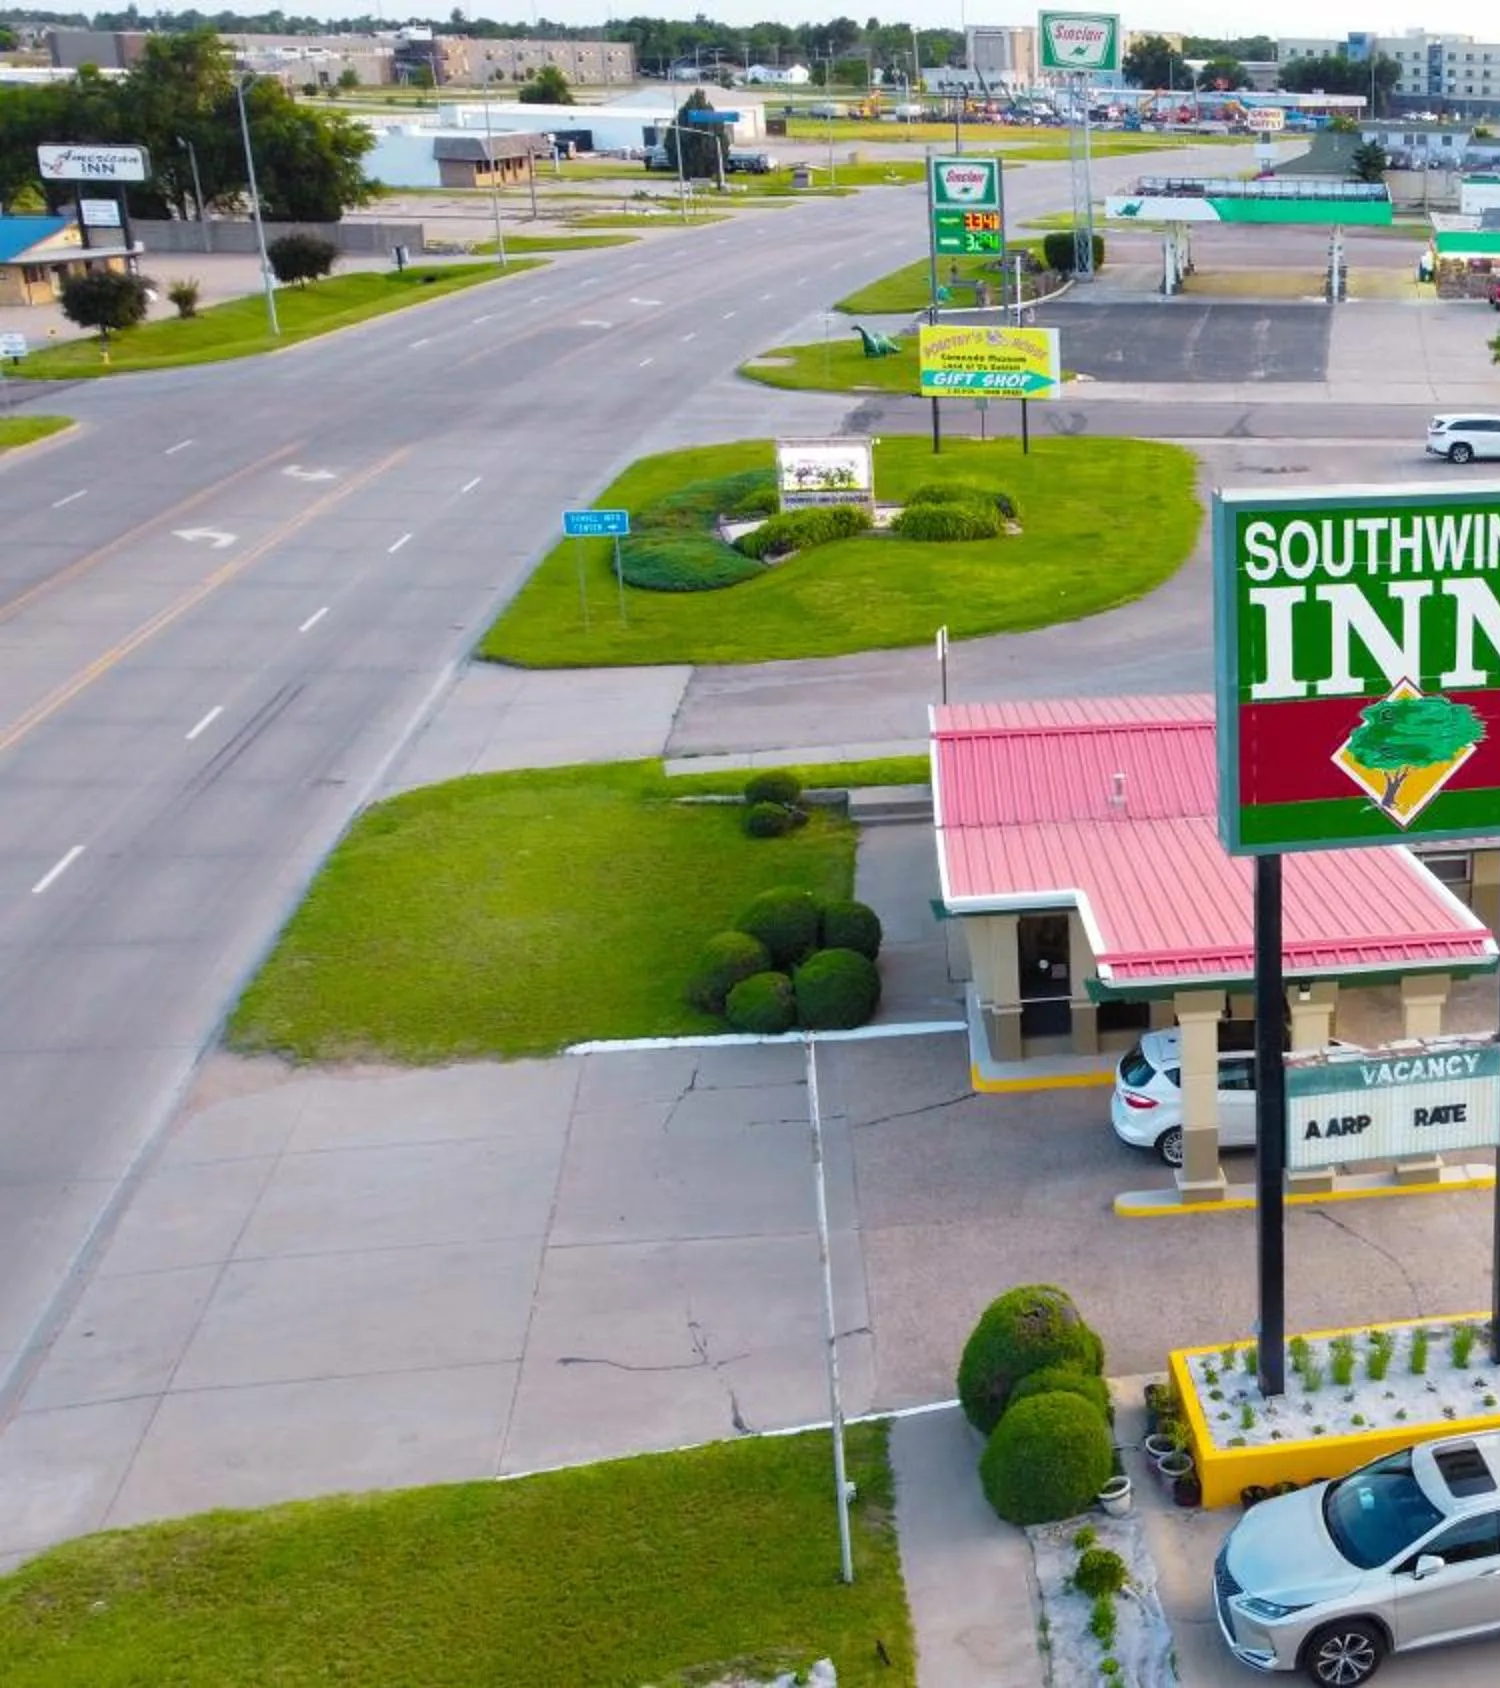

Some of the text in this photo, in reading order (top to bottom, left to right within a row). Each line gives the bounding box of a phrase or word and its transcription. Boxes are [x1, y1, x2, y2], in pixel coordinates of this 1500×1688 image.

[1055, 24, 1104, 41] Sinclair
[81, 163, 115, 174] INN
[933, 372, 1033, 387] GIFT SHOP
[1360, 1053, 1480, 1085] VACANCY
[1414, 1103, 1467, 1127] RATE
